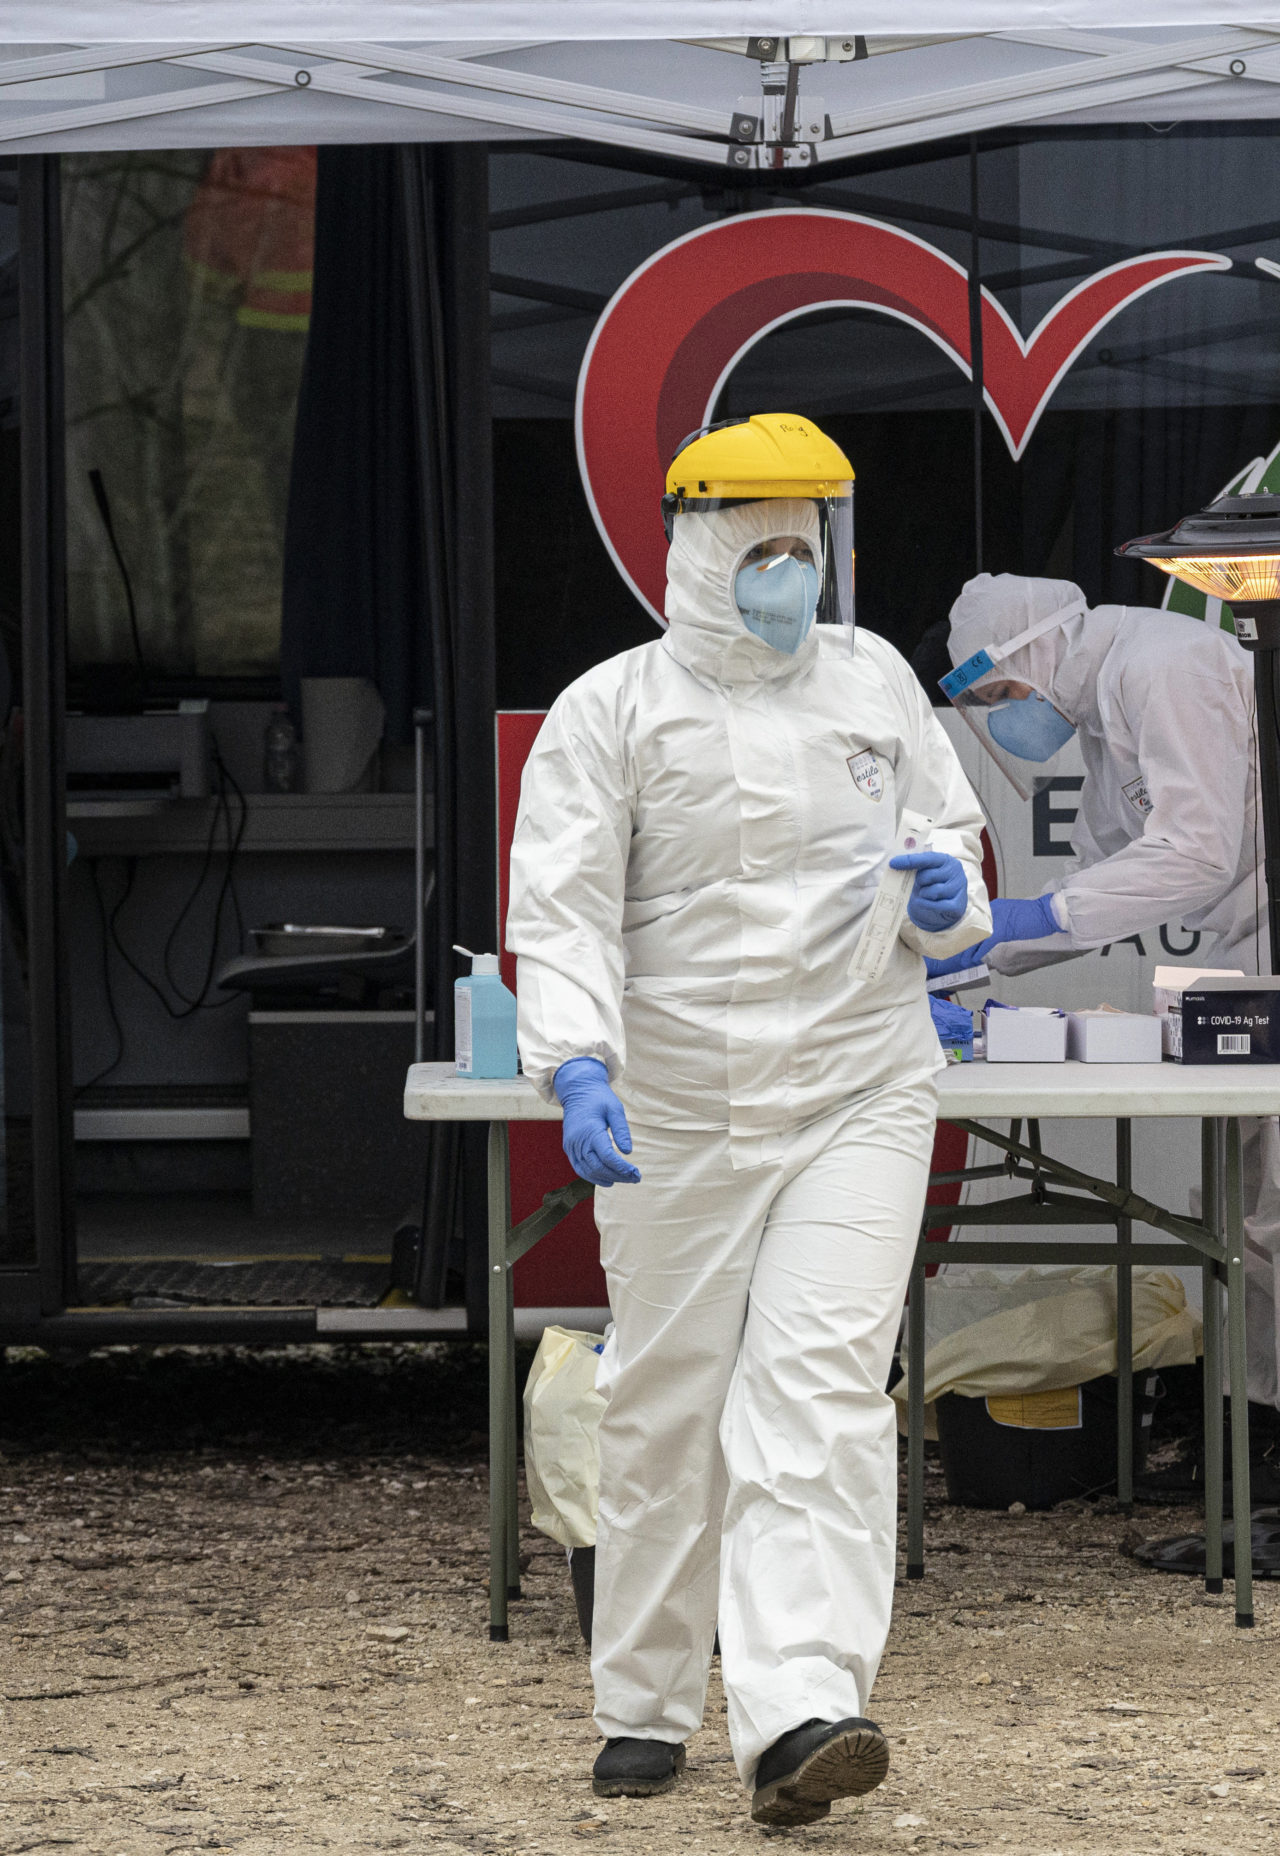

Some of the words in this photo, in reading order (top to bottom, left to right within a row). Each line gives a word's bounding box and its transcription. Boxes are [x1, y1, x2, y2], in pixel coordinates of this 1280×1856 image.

[856, 765, 879, 782] estilo
[1211, 1016, 1242, 1025] COVID-19
[1243, 1016, 1253, 1027] Ag
[1254, 1015, 1270, 1025] Test
